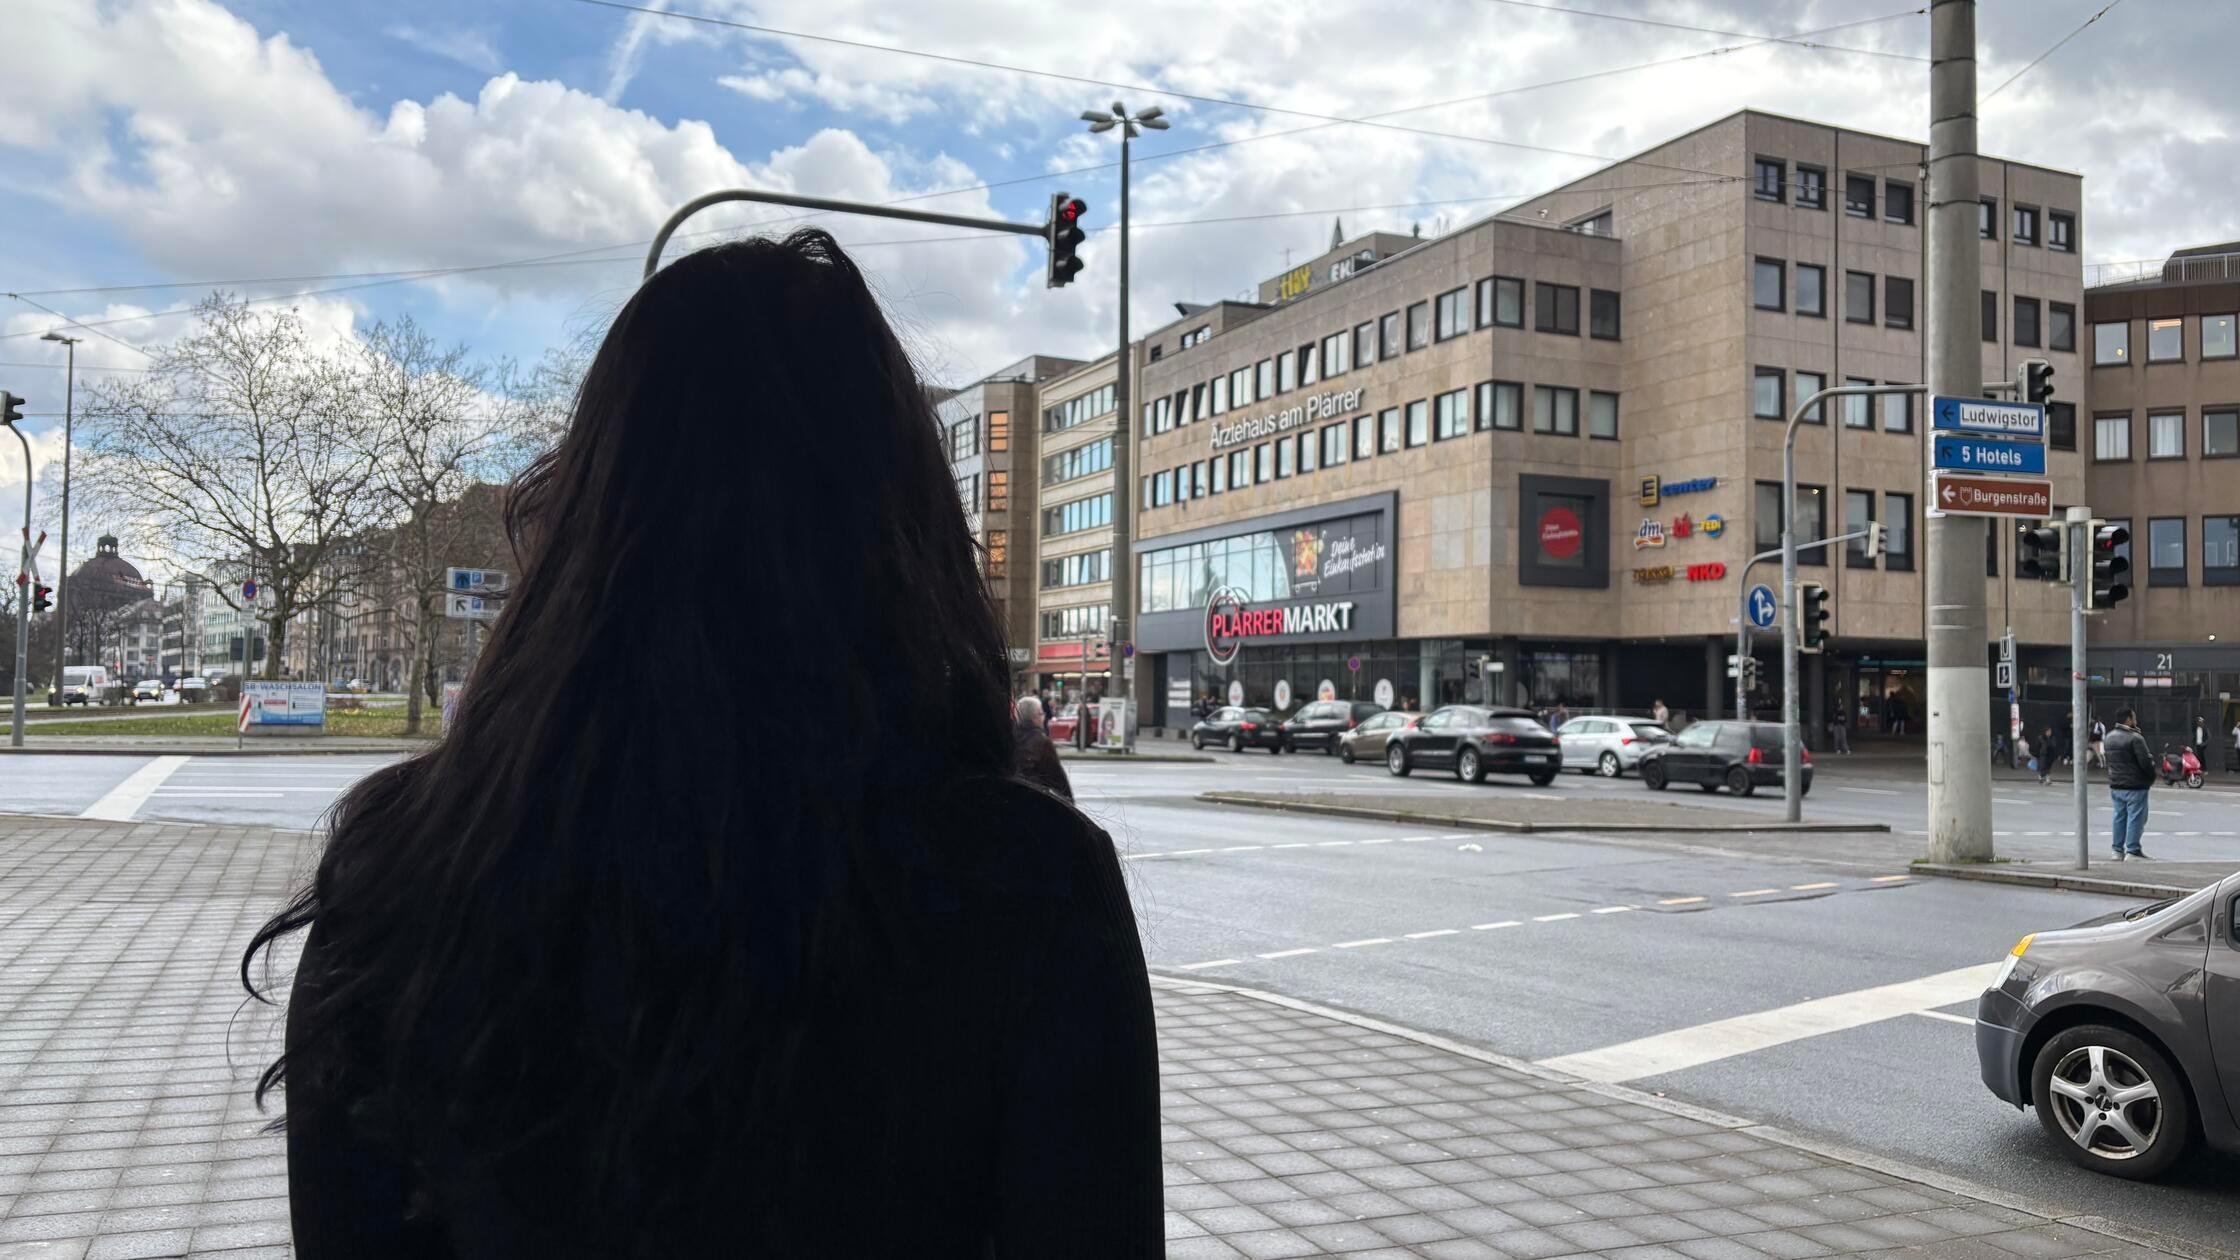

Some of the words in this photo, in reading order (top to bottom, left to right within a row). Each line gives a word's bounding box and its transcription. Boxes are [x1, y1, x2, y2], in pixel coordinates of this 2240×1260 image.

[1210, 415, 1276, 448] Ärztehaus
[1279, 406, 1303, 430] am
[1307, 388, 1362, 422] Plärrer
[1961, 407, 2037, 428] Ludwigstor
[1962, 446, 1971, 463] 5
[1976, 447, 2022, 466] Hotels
[1642, 480, 1655, 498] E
[1974, 489, 2048, 506] Burgenstraße
[1640, 519, 1660, 537] dm
[2157, 653, 2173, 670] 21
